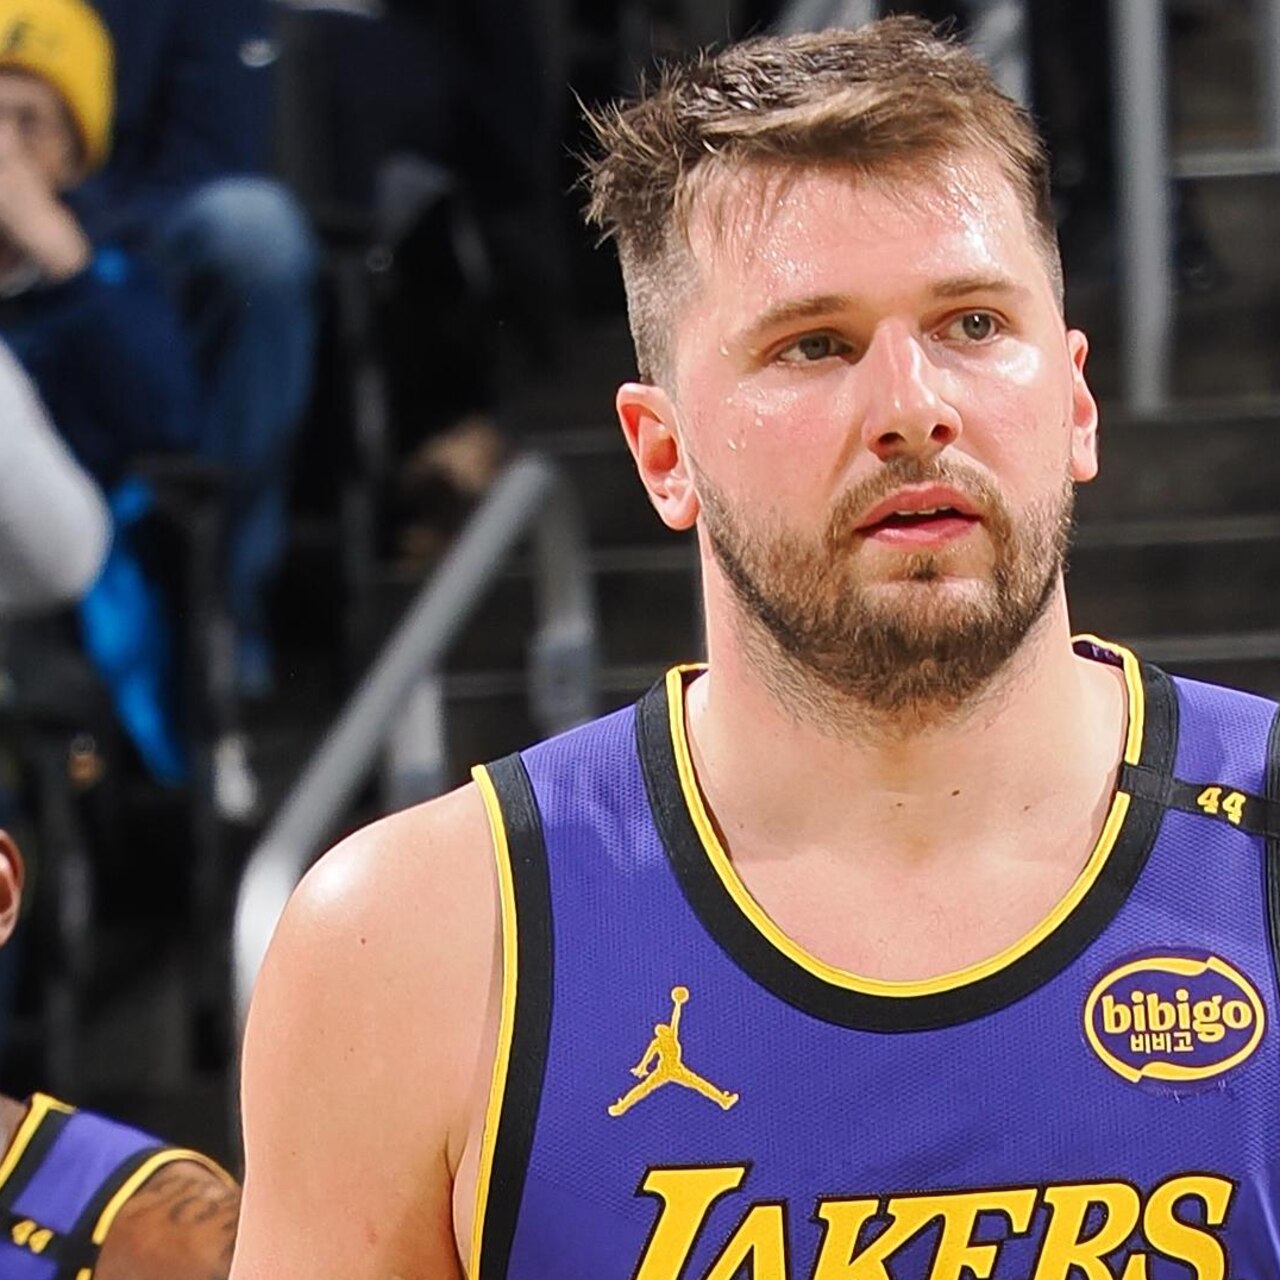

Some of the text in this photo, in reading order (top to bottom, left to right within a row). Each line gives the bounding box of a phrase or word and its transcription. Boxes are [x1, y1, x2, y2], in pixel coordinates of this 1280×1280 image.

[1197, 786, 1246, 825] 44
[1101, 989, 1252, 1043] bibigo
[1130, 1031, 1194, 1053] 비비고
